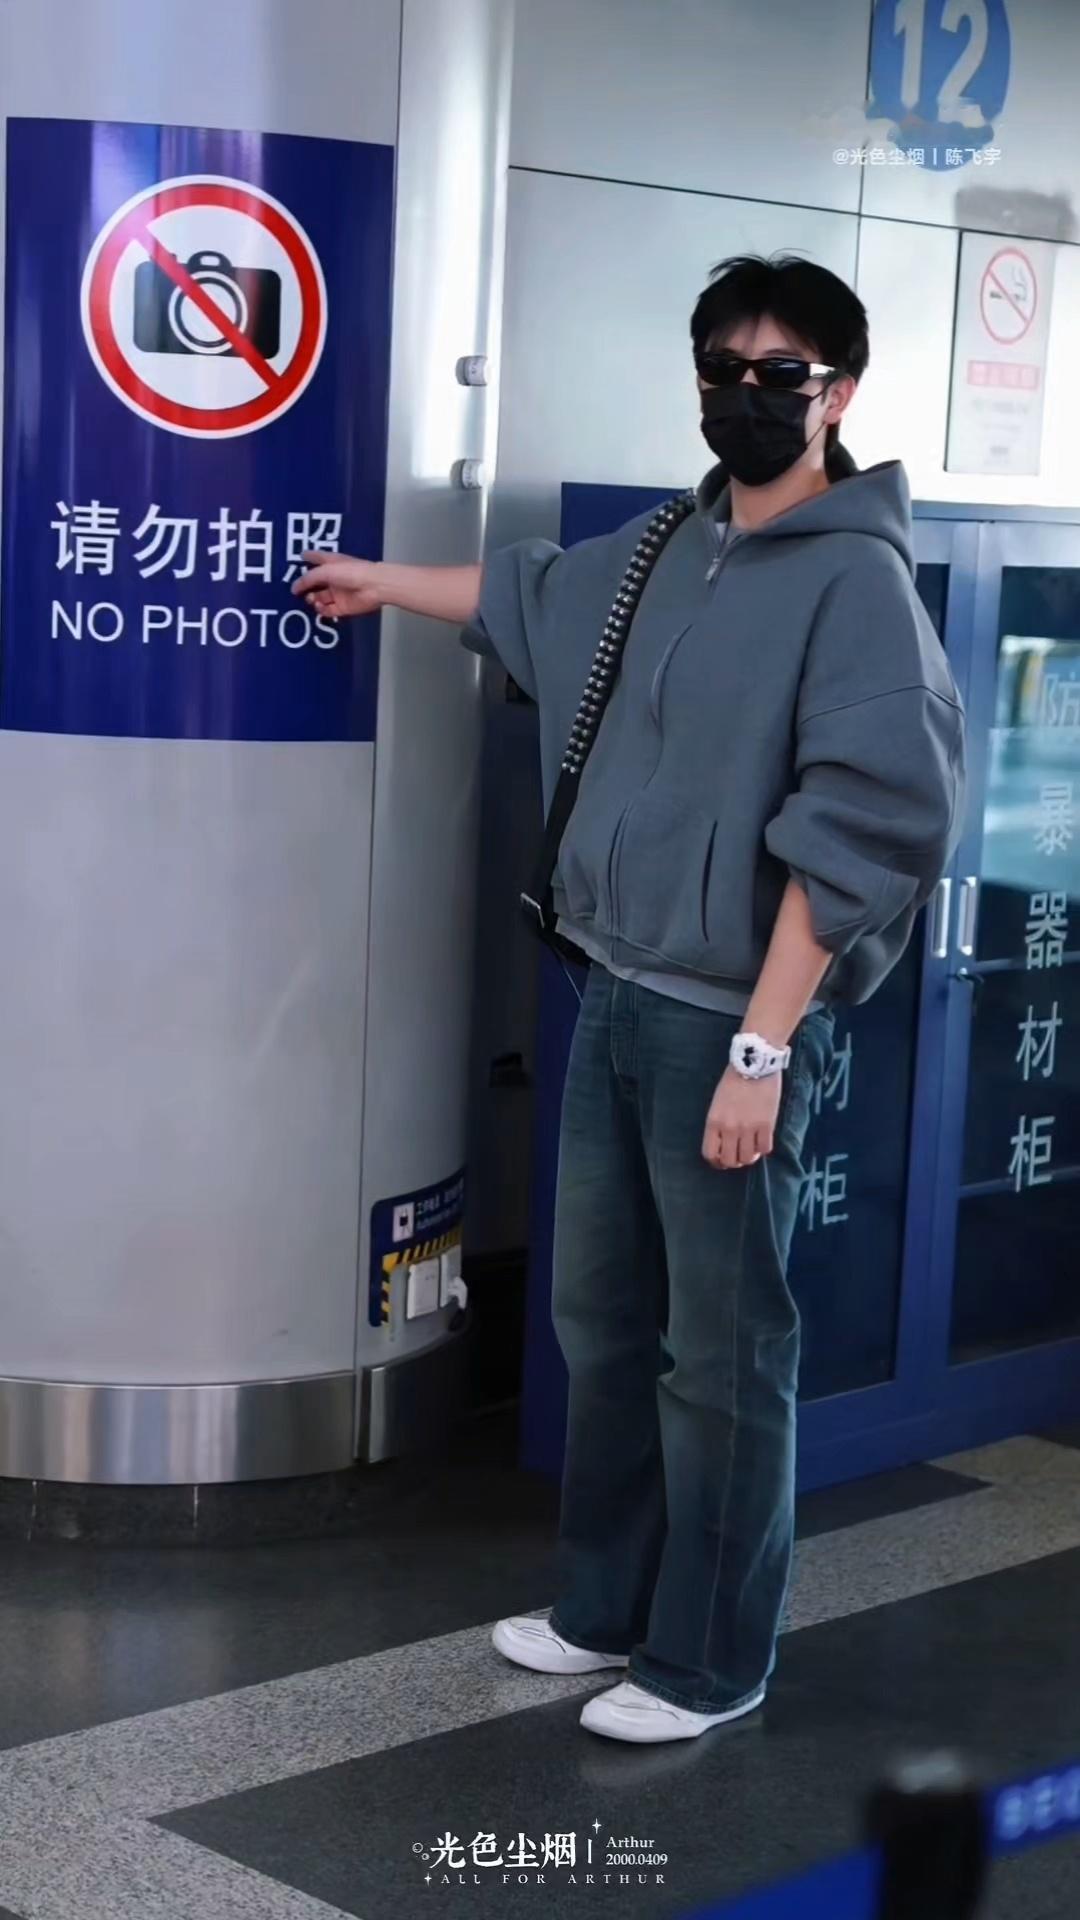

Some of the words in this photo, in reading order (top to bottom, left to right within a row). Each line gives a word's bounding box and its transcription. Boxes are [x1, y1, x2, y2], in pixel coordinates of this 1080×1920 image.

[893, 0, 988, 127] 12
[51, 600, 124, 642] NO
[142, 604, 339, 650] PHOTOS
